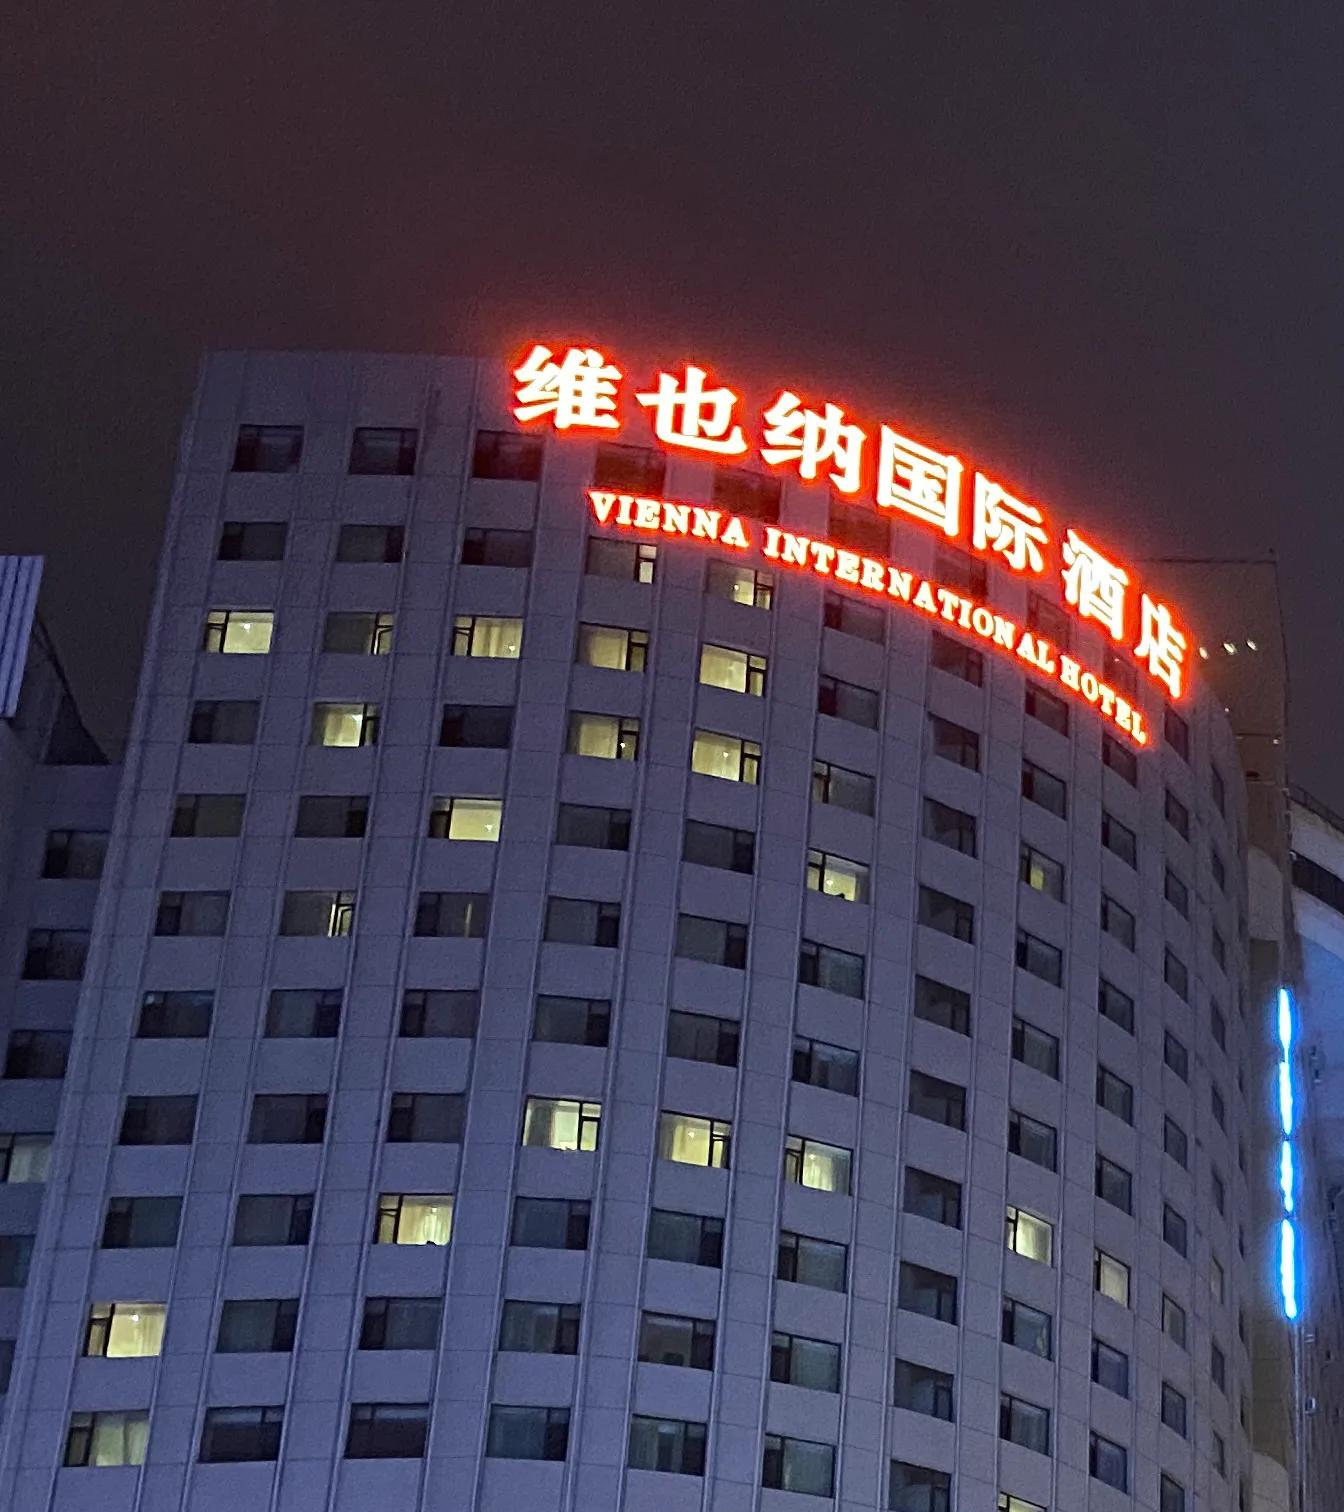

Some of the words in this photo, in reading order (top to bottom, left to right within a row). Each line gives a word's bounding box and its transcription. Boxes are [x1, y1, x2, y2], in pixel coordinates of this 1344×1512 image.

[514, 345, 1187, 698] 维也纳国际酒店
[588, 491, 749, 548] VIENNA
[764, 526, 1056, 673] INTERNATIONAL
[1059, 655, 1147, 744] HOTEL
